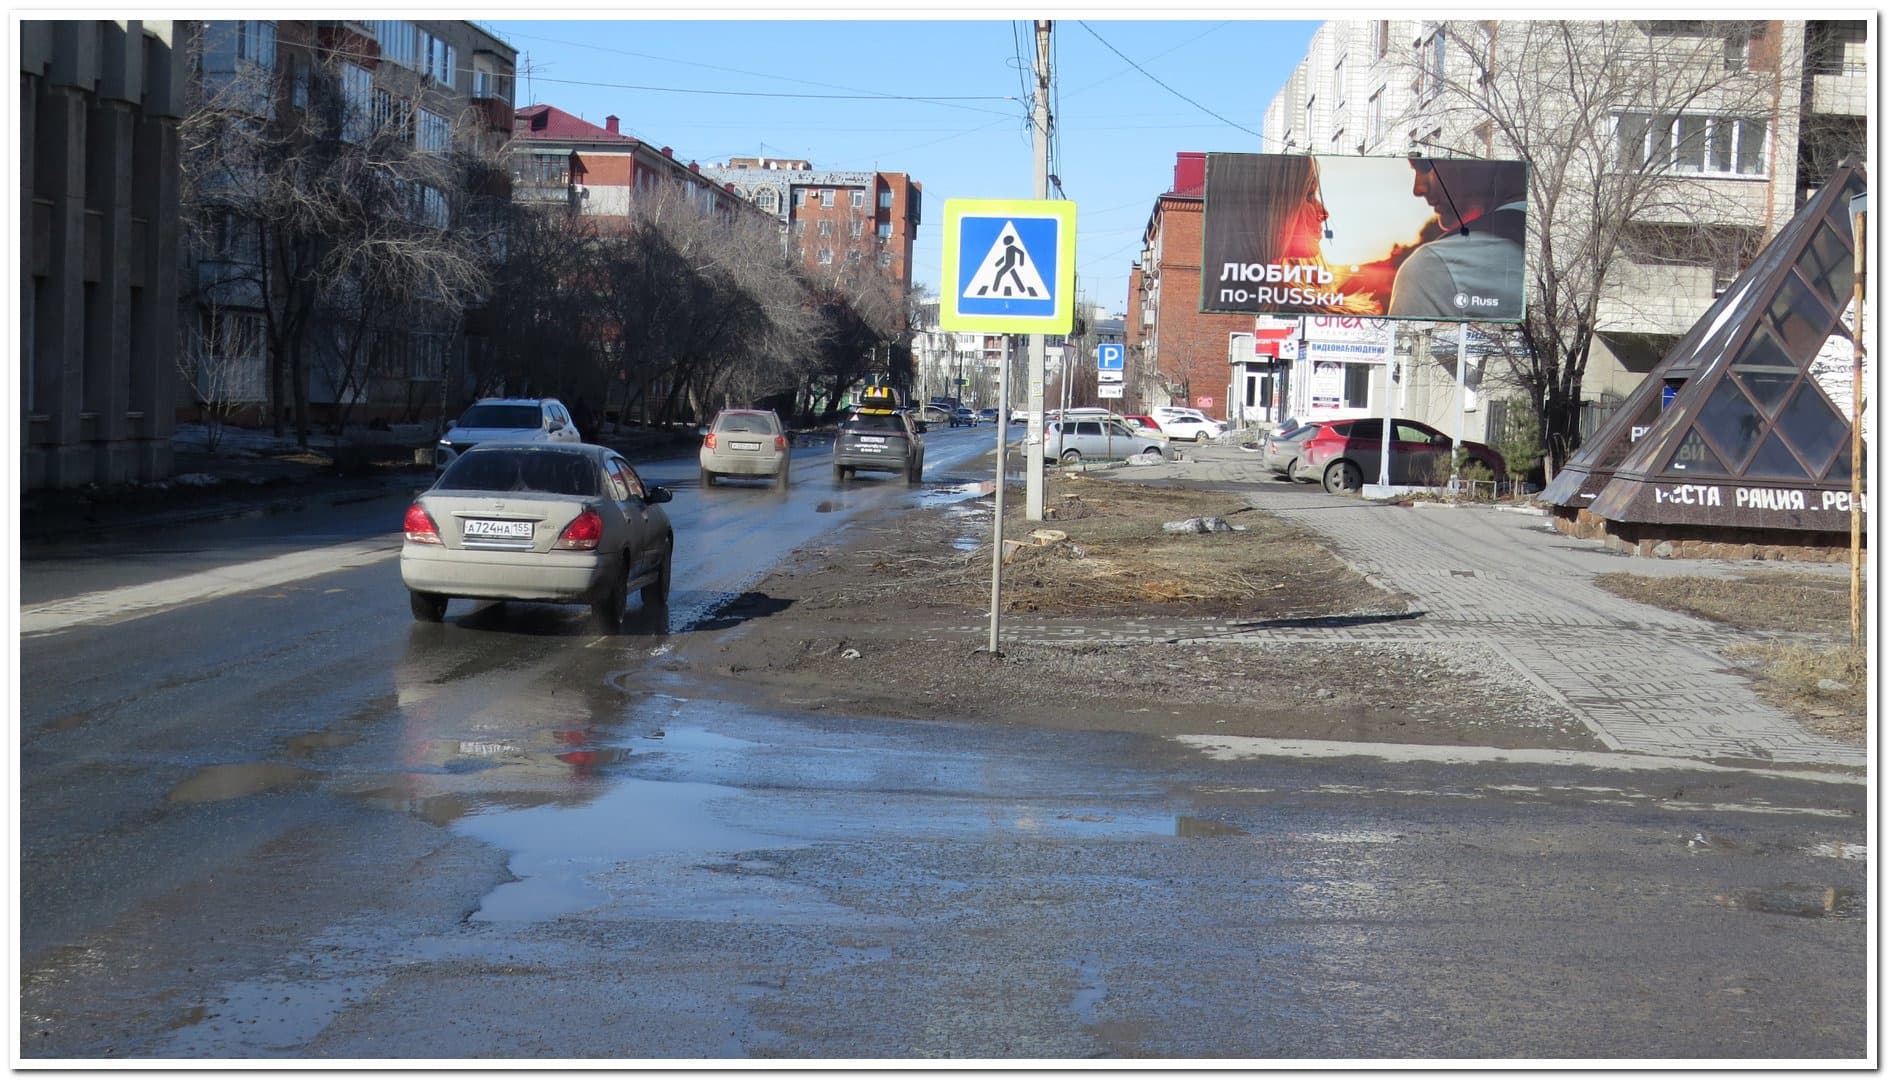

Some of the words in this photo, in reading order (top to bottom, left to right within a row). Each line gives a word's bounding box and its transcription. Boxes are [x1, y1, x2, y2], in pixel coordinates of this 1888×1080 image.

[1220, 262, 1334, 284] ЛЮБИТЬ
[1220, 286, 1345, 306] по-RUSSки
[1471, 295, 1499, 306] Russ
[1104, 347, 1119, 367] P
[1311, 343, 1386, 354] ВИДЕОНАБЛЮДЕНИЕ
[1735, 487, 1805, 511] РАЦИЯ
[468, 521, 512, 534] А724НА
[513, 522, 530, 533] 155
